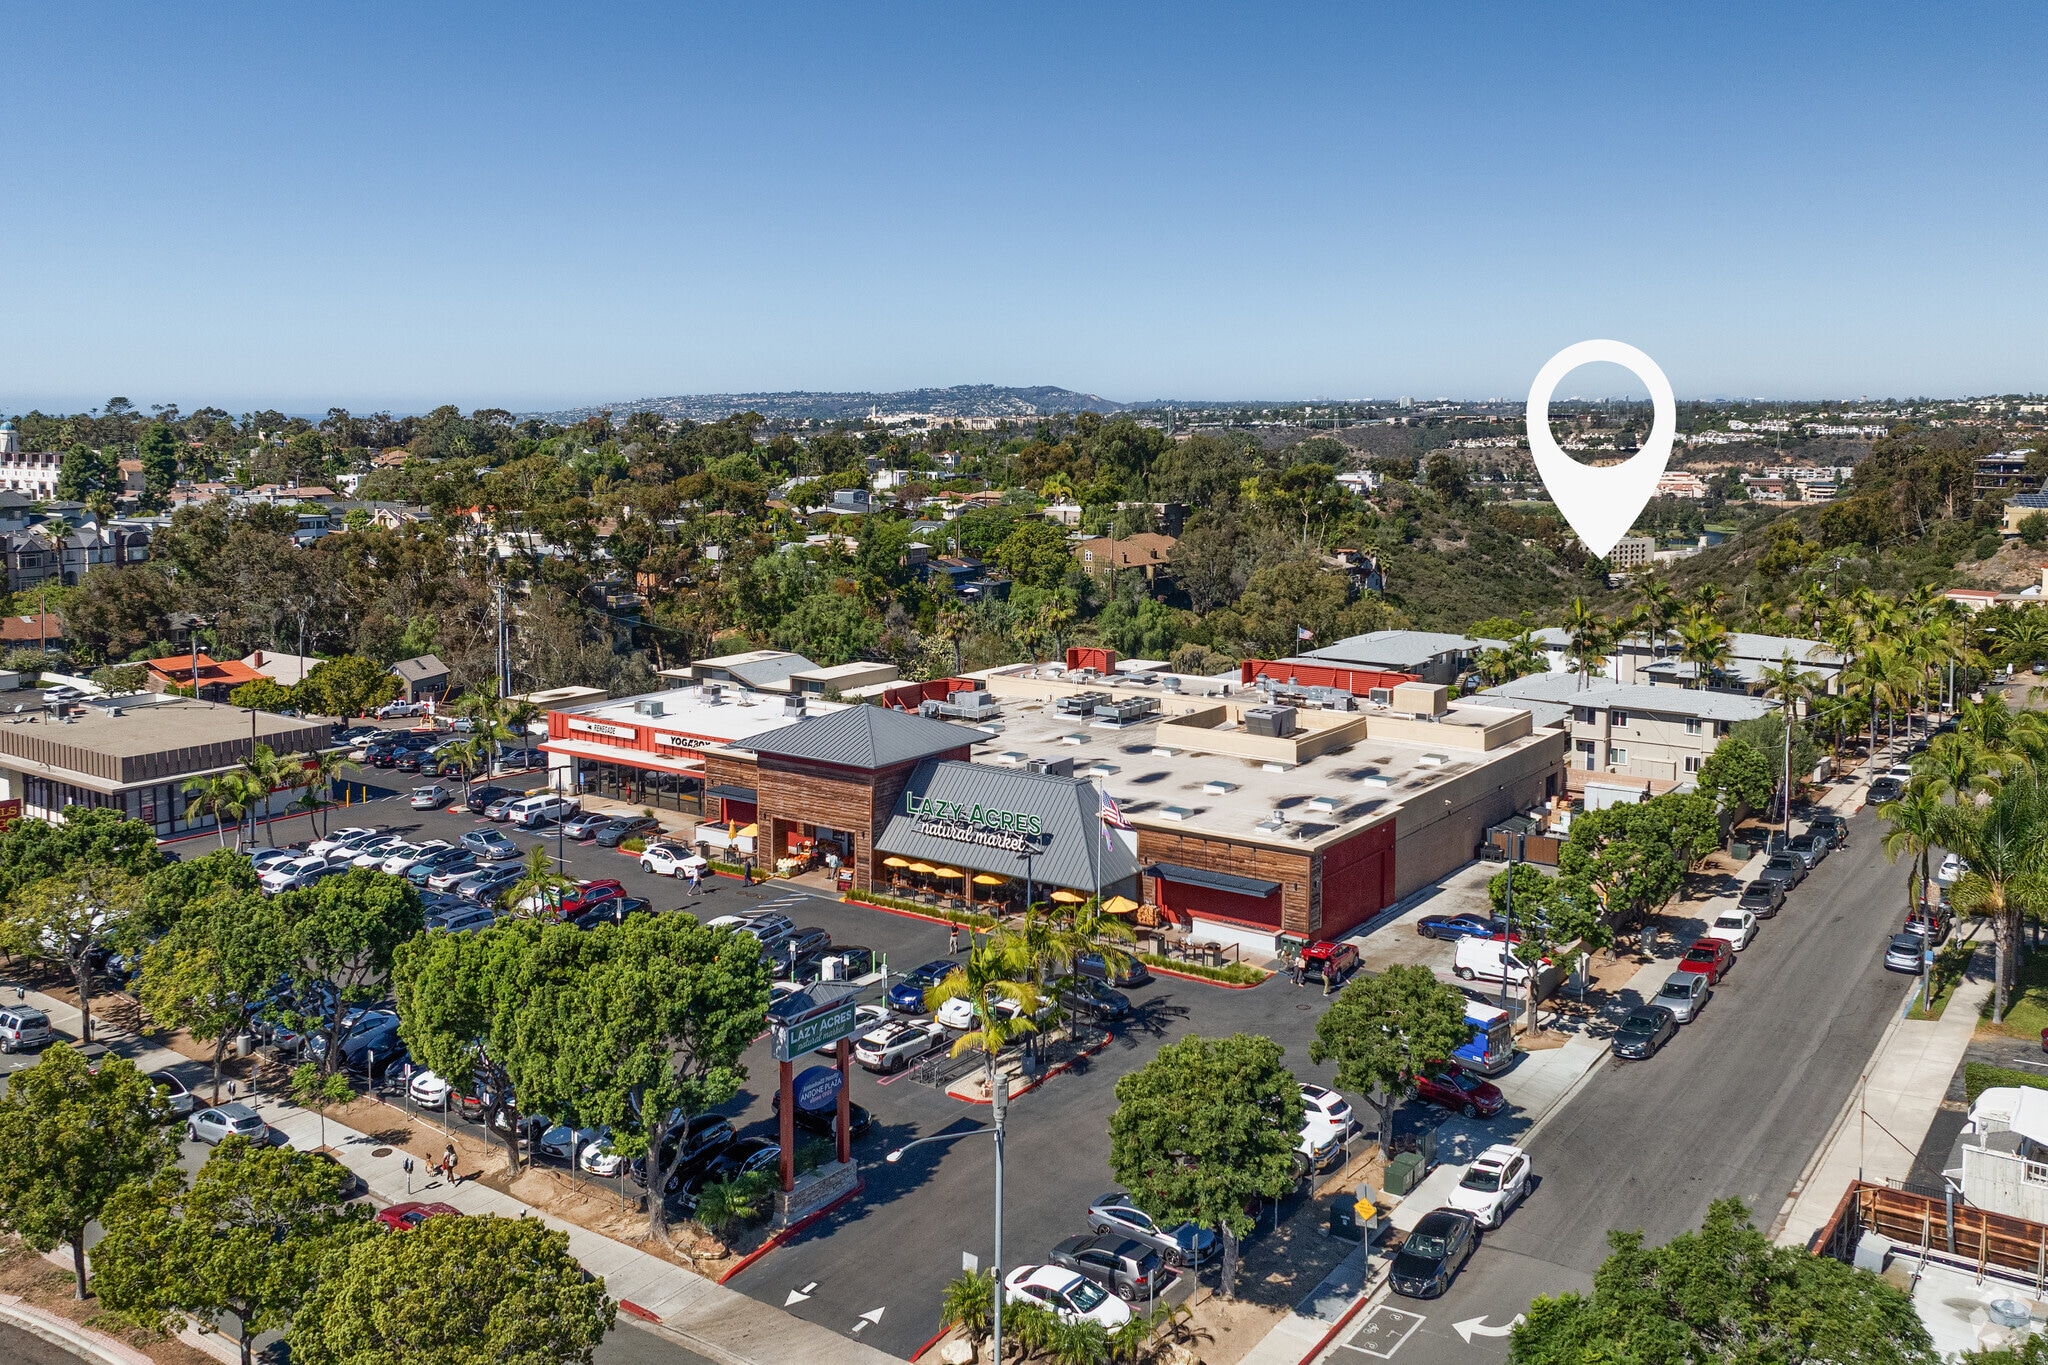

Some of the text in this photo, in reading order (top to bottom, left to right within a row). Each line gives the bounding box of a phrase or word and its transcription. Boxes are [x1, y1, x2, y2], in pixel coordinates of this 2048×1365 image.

[594, 724, 616, 734] RENEGADE
[906, 791, 1042, 835] LAZY ACRES
[920, 821, 1026, 851] natural market
[790, 1010, 852, 1043] LAZY ACRES
[800, 1084, 824, 1102] ANTONE
[824, 1078, 842, 1092] PLAZA
